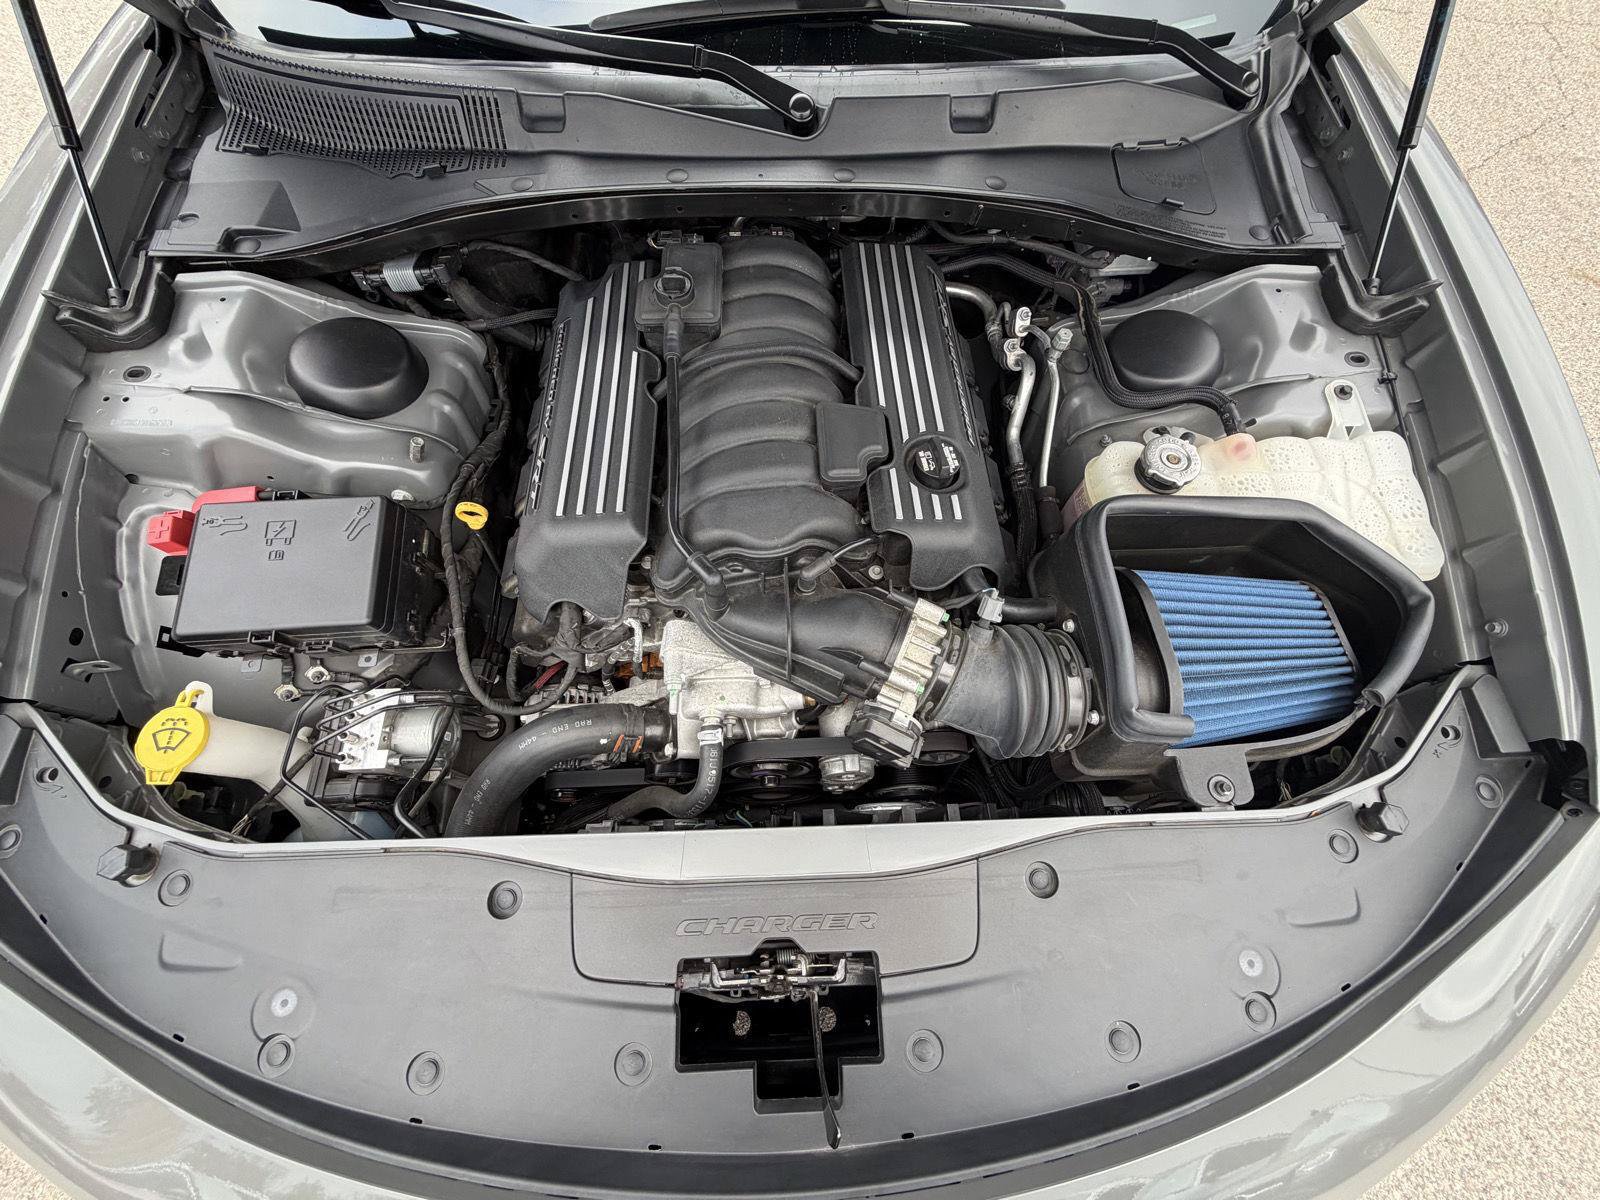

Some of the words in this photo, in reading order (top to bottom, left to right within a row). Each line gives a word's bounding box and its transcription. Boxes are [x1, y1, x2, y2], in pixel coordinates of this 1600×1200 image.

[549, 323, 565, 401] POWERED
[544, 404, 554, 428] BY
[531, 434, 548, 510] SRT
[551, 723, 569, 734] END
[574, 719, 593, 728] RAD
[675, 912, 880, 937] CHARGER
